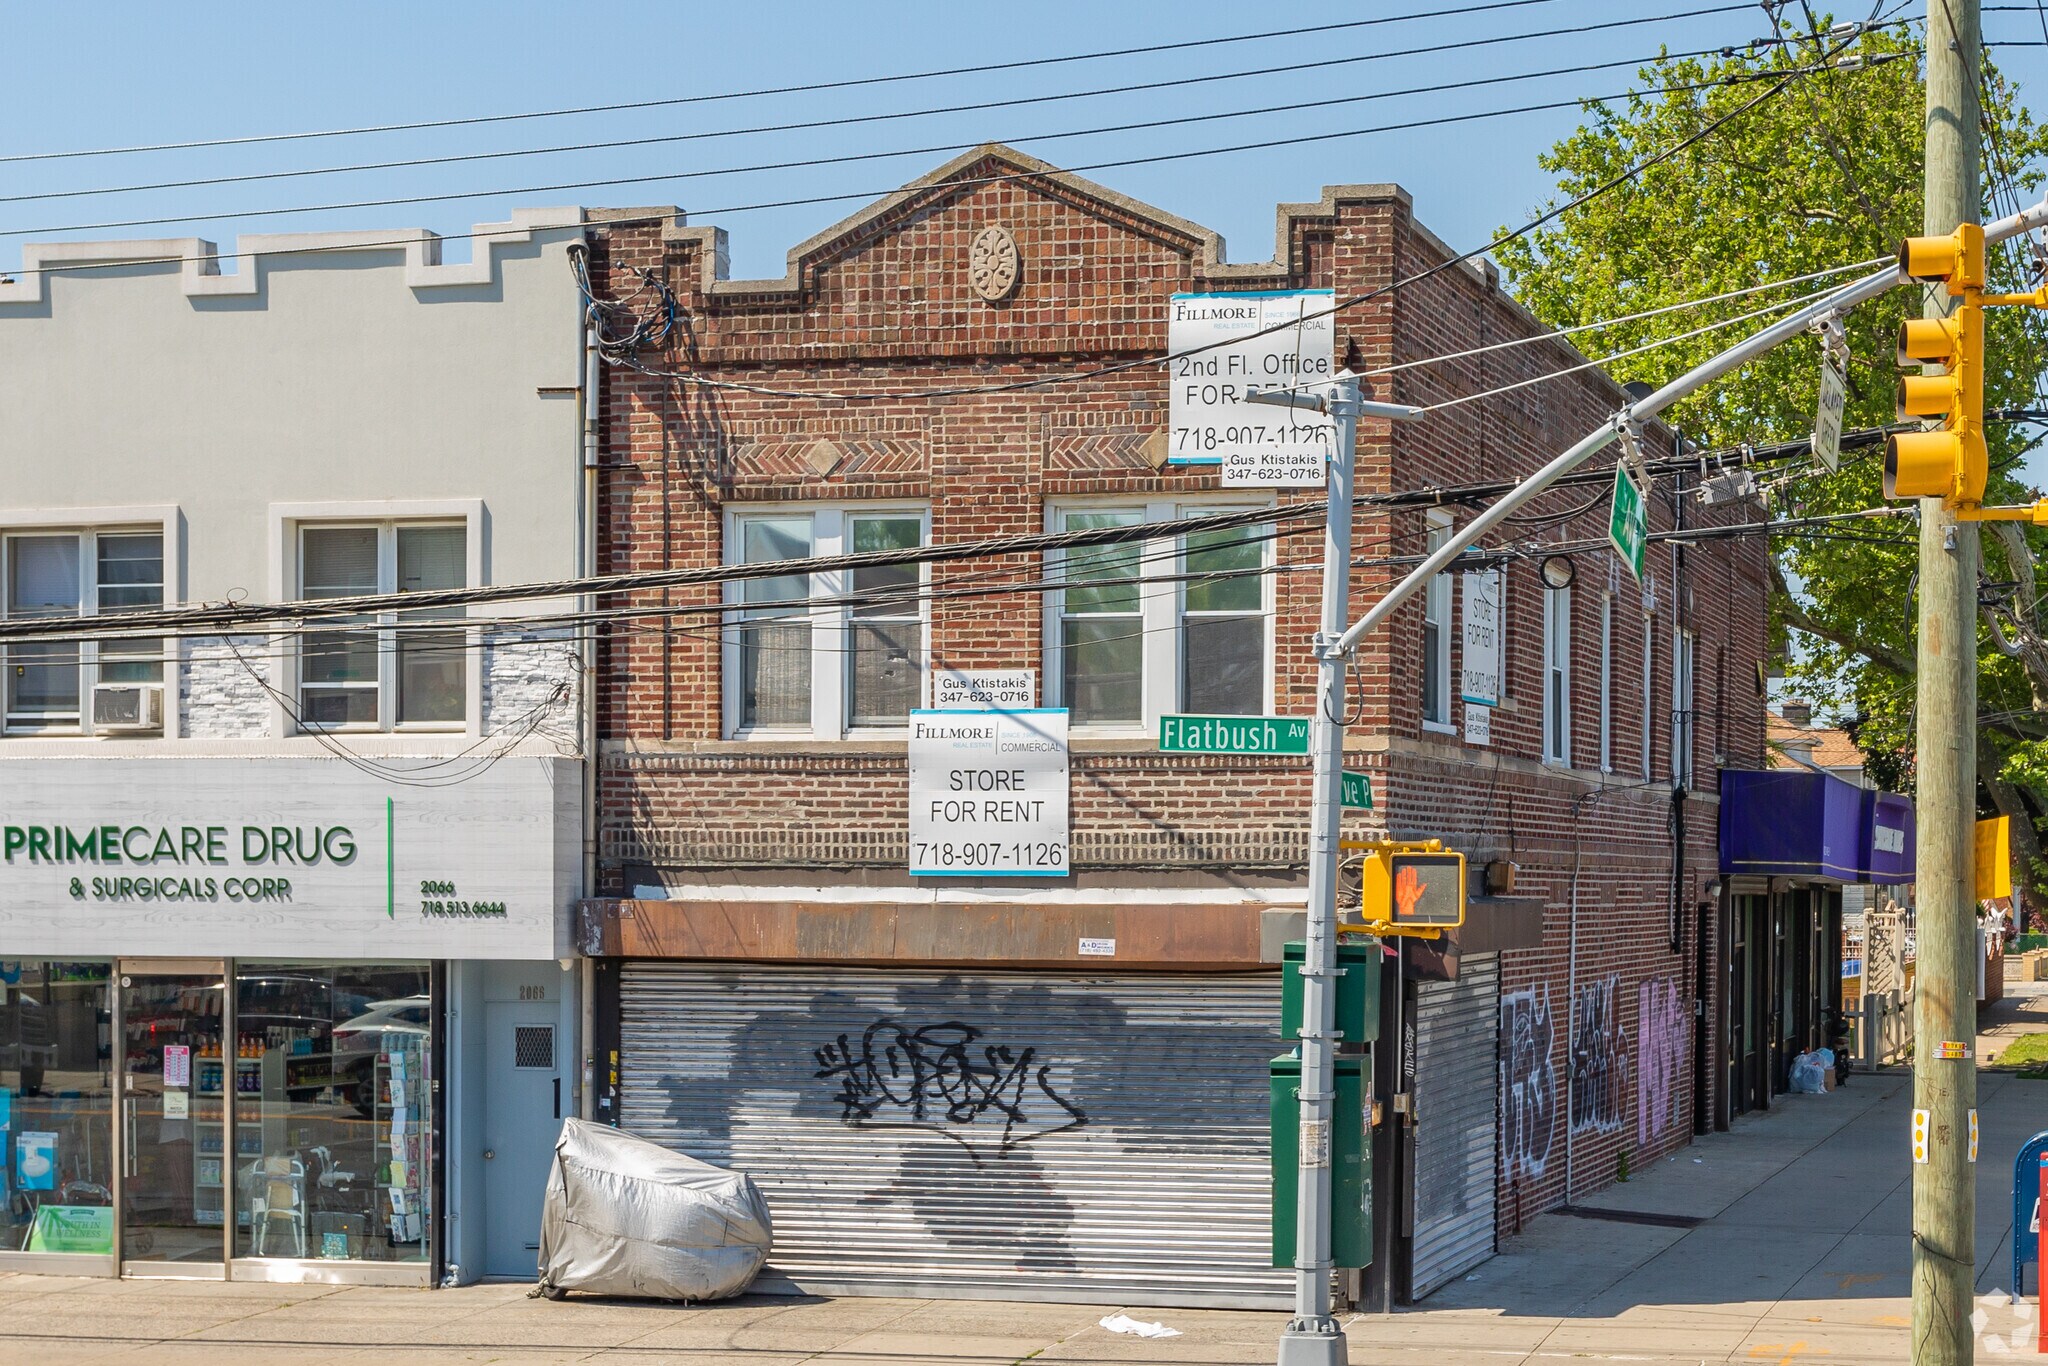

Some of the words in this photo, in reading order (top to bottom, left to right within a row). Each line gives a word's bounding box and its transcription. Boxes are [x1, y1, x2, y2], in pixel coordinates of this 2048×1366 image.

[1176, 305, 1257, 321] FILLMORE
[1213, 322, 1230, 330] REAL
[1231, 322, 1255, 330] ESTATE
[1265, 320, 1326, 331] COERCIAL
[1179, 355, 1218, 377] 2nd
[1228, 354, 1253, 376] Fl.
[1263, 353, 1328, 375] Office
[1186, 385, 1237, 405] FOR
[1177, 425, 1328, 451] 718-907-1126
[1230, 454, 1255, 466] Gus
[1261, 453, 1318, 466] Ktistakis
[1227, 468, 1320, 480] 347-623-0716
[943, 678, 967, 689] Gus
[973, 677, 1027, 689] Ktistakis
[940, 691, 1029, 703] 347-623-0716
[915, 723, 993, 739] FILLMORE
[1164, 719, 1277, 750] Flatbush
[1288, 723, 1306, 738] Av
[1001, 742, 1061, 752] COMMERCIAL
[949, 769, 1026, 791] STORE
[1343, 778, 1358, 804] ve
[1363, 780, 1371, 805] P
[931, 801, 976, 822] FOR
[984, 801, 1045, 823] RENT
[3, 826, 226, 862] PRIMECARE
[243, 826, 356, 862] DRUG
[916, 843, 1062, 866] 718-907-1126
[69, 877, 84, 897] &
[92, 877, 215, 898] SURGICALS
[223, 877, 291, 898] CORP.
[420, 880, 455, 894] 2066
[421, 901, 506, 915] 718.513.6644
[520, 985, 545, 1000] 2066
